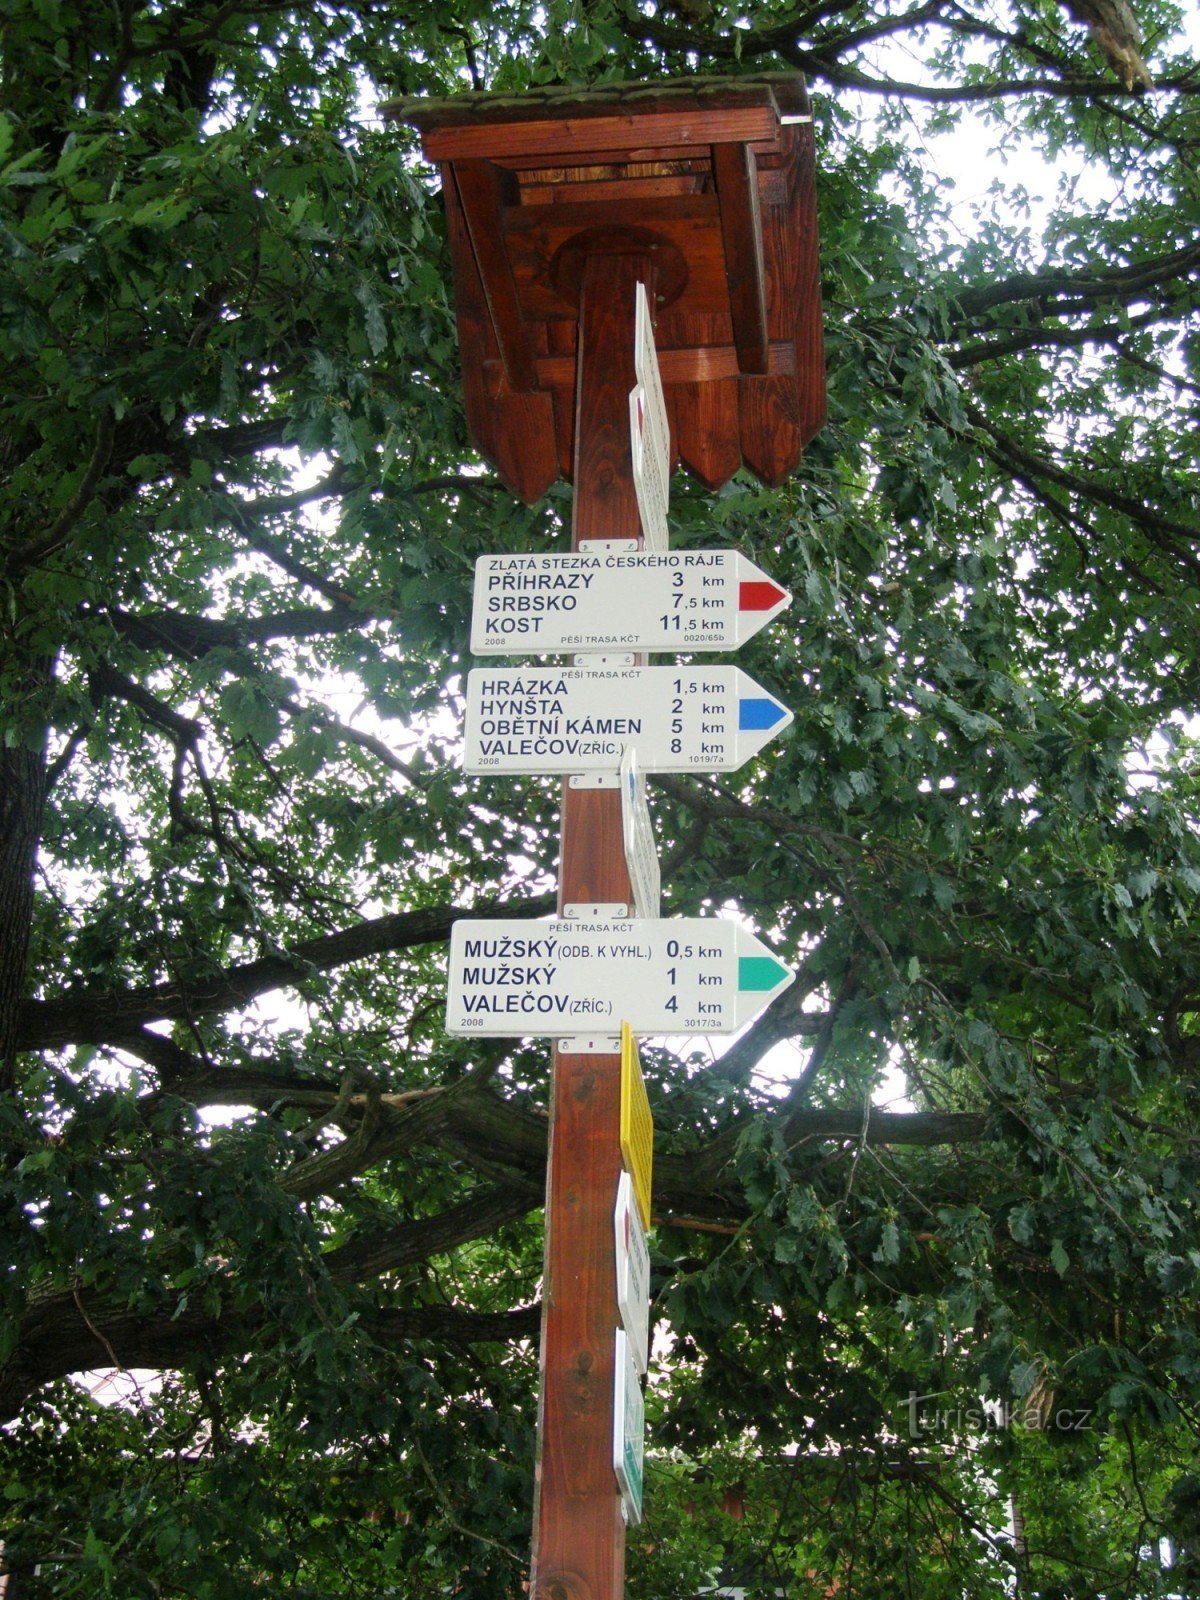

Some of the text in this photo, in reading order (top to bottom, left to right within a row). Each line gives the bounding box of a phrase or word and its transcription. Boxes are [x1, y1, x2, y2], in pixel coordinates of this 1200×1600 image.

[489, 554, 724, 570] ZLATÁ STEZKA ČESKÉHO RÁJE
[489, 572, 724, 590] PŘÍHRAZY 3 km
[488, 593, 724, 612] SRBSKO 7,5 km
[486, 615, 723, 633] KOST 11,5 km
[621, 634, 640, 642] KČT
[622, 670, 640, 678] KČT
[482, 679, 724, 695] HRÁZKA 1,5 km
[481, 698, 724, 715] HYNŠTA 2 km
[481, 716, 724, 735] OBĚTNÍ KÁMEN 5 km
[671, 739, 681, 753] 8
[702, 743, 723, 753] km
[613, 923, 633, 932] KČT
[598, 946, 605, 957] K
[610, 946, 651, 960] VYHL.)
[667, 940, 692, 959] 0,5
[699, 946, 721, 957] km
[463, 963, 722, 985] MUŽSKÝ 1 km
[665, 995, 678, 1013] 4
[699, 1001, 721, 1013] km
[685, 1019, 721, 1027] 3017/3a
